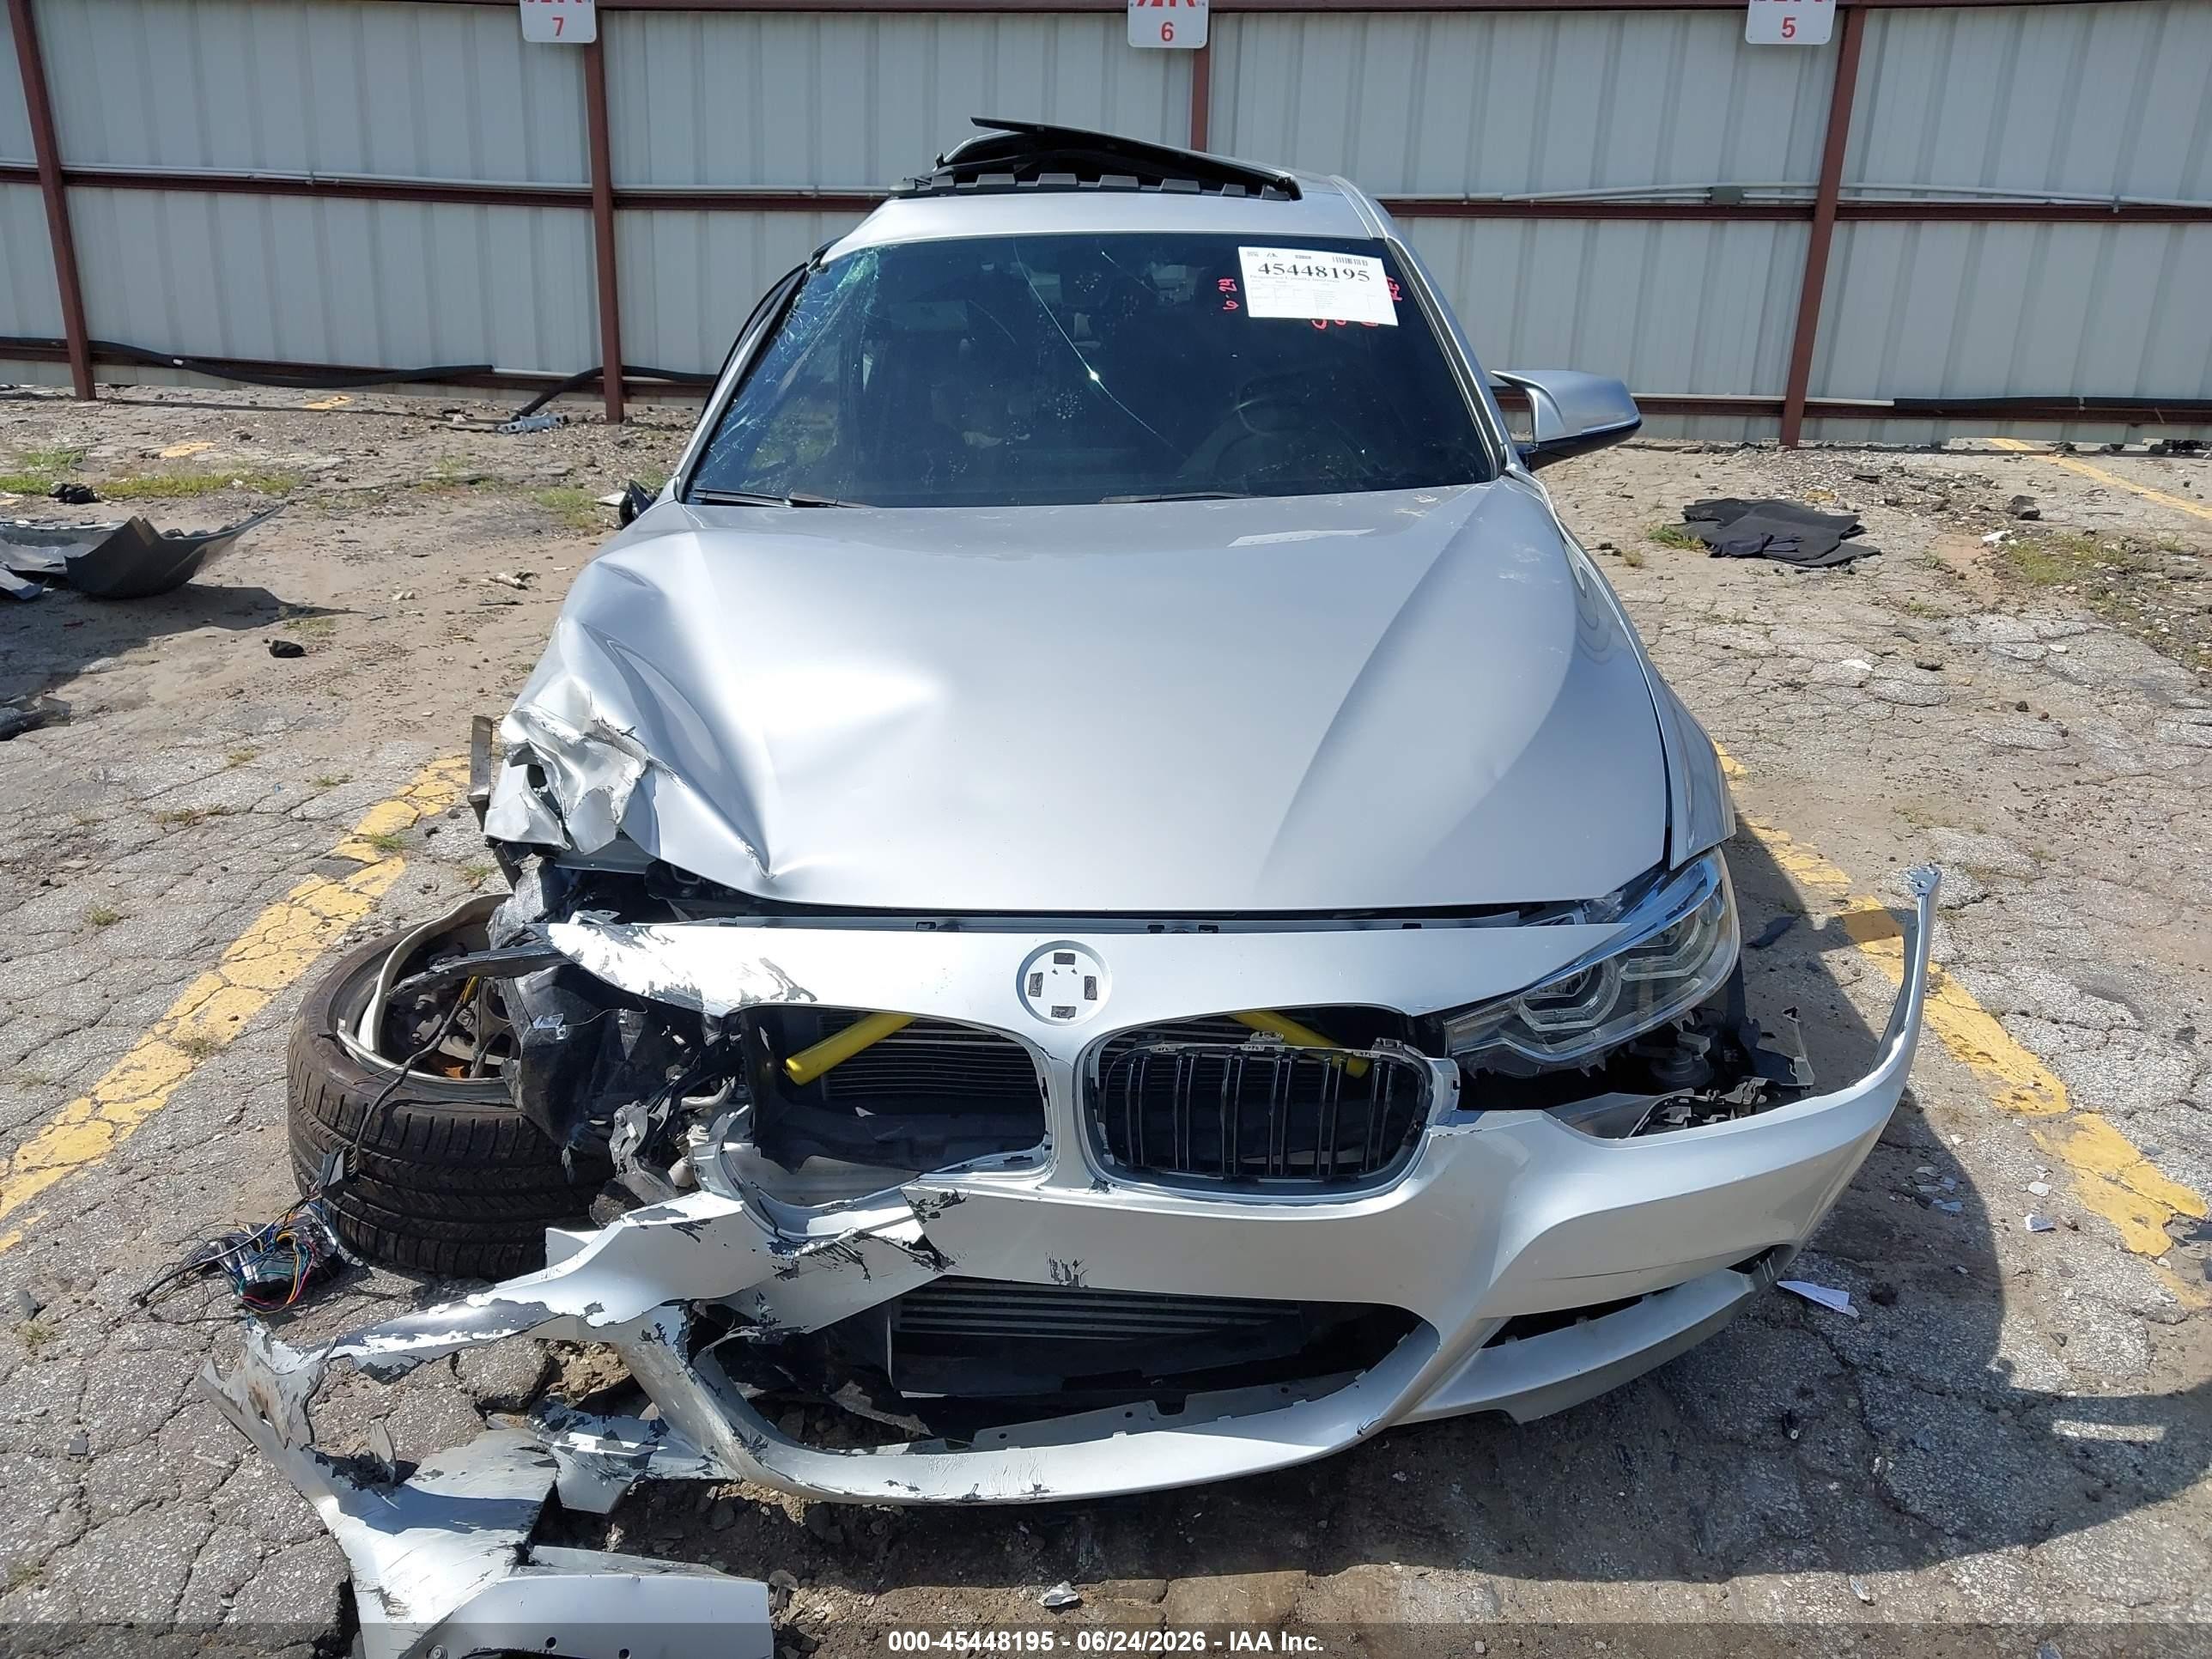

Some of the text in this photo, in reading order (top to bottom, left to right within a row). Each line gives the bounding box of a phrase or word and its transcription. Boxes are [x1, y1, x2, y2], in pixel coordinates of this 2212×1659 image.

[552, 17, 564, 36] 7
[1161, 21, 1174, 41] 6
[1782, 17, 1796, 38] 5
[1257, 262, 1370, 283] 45448195
